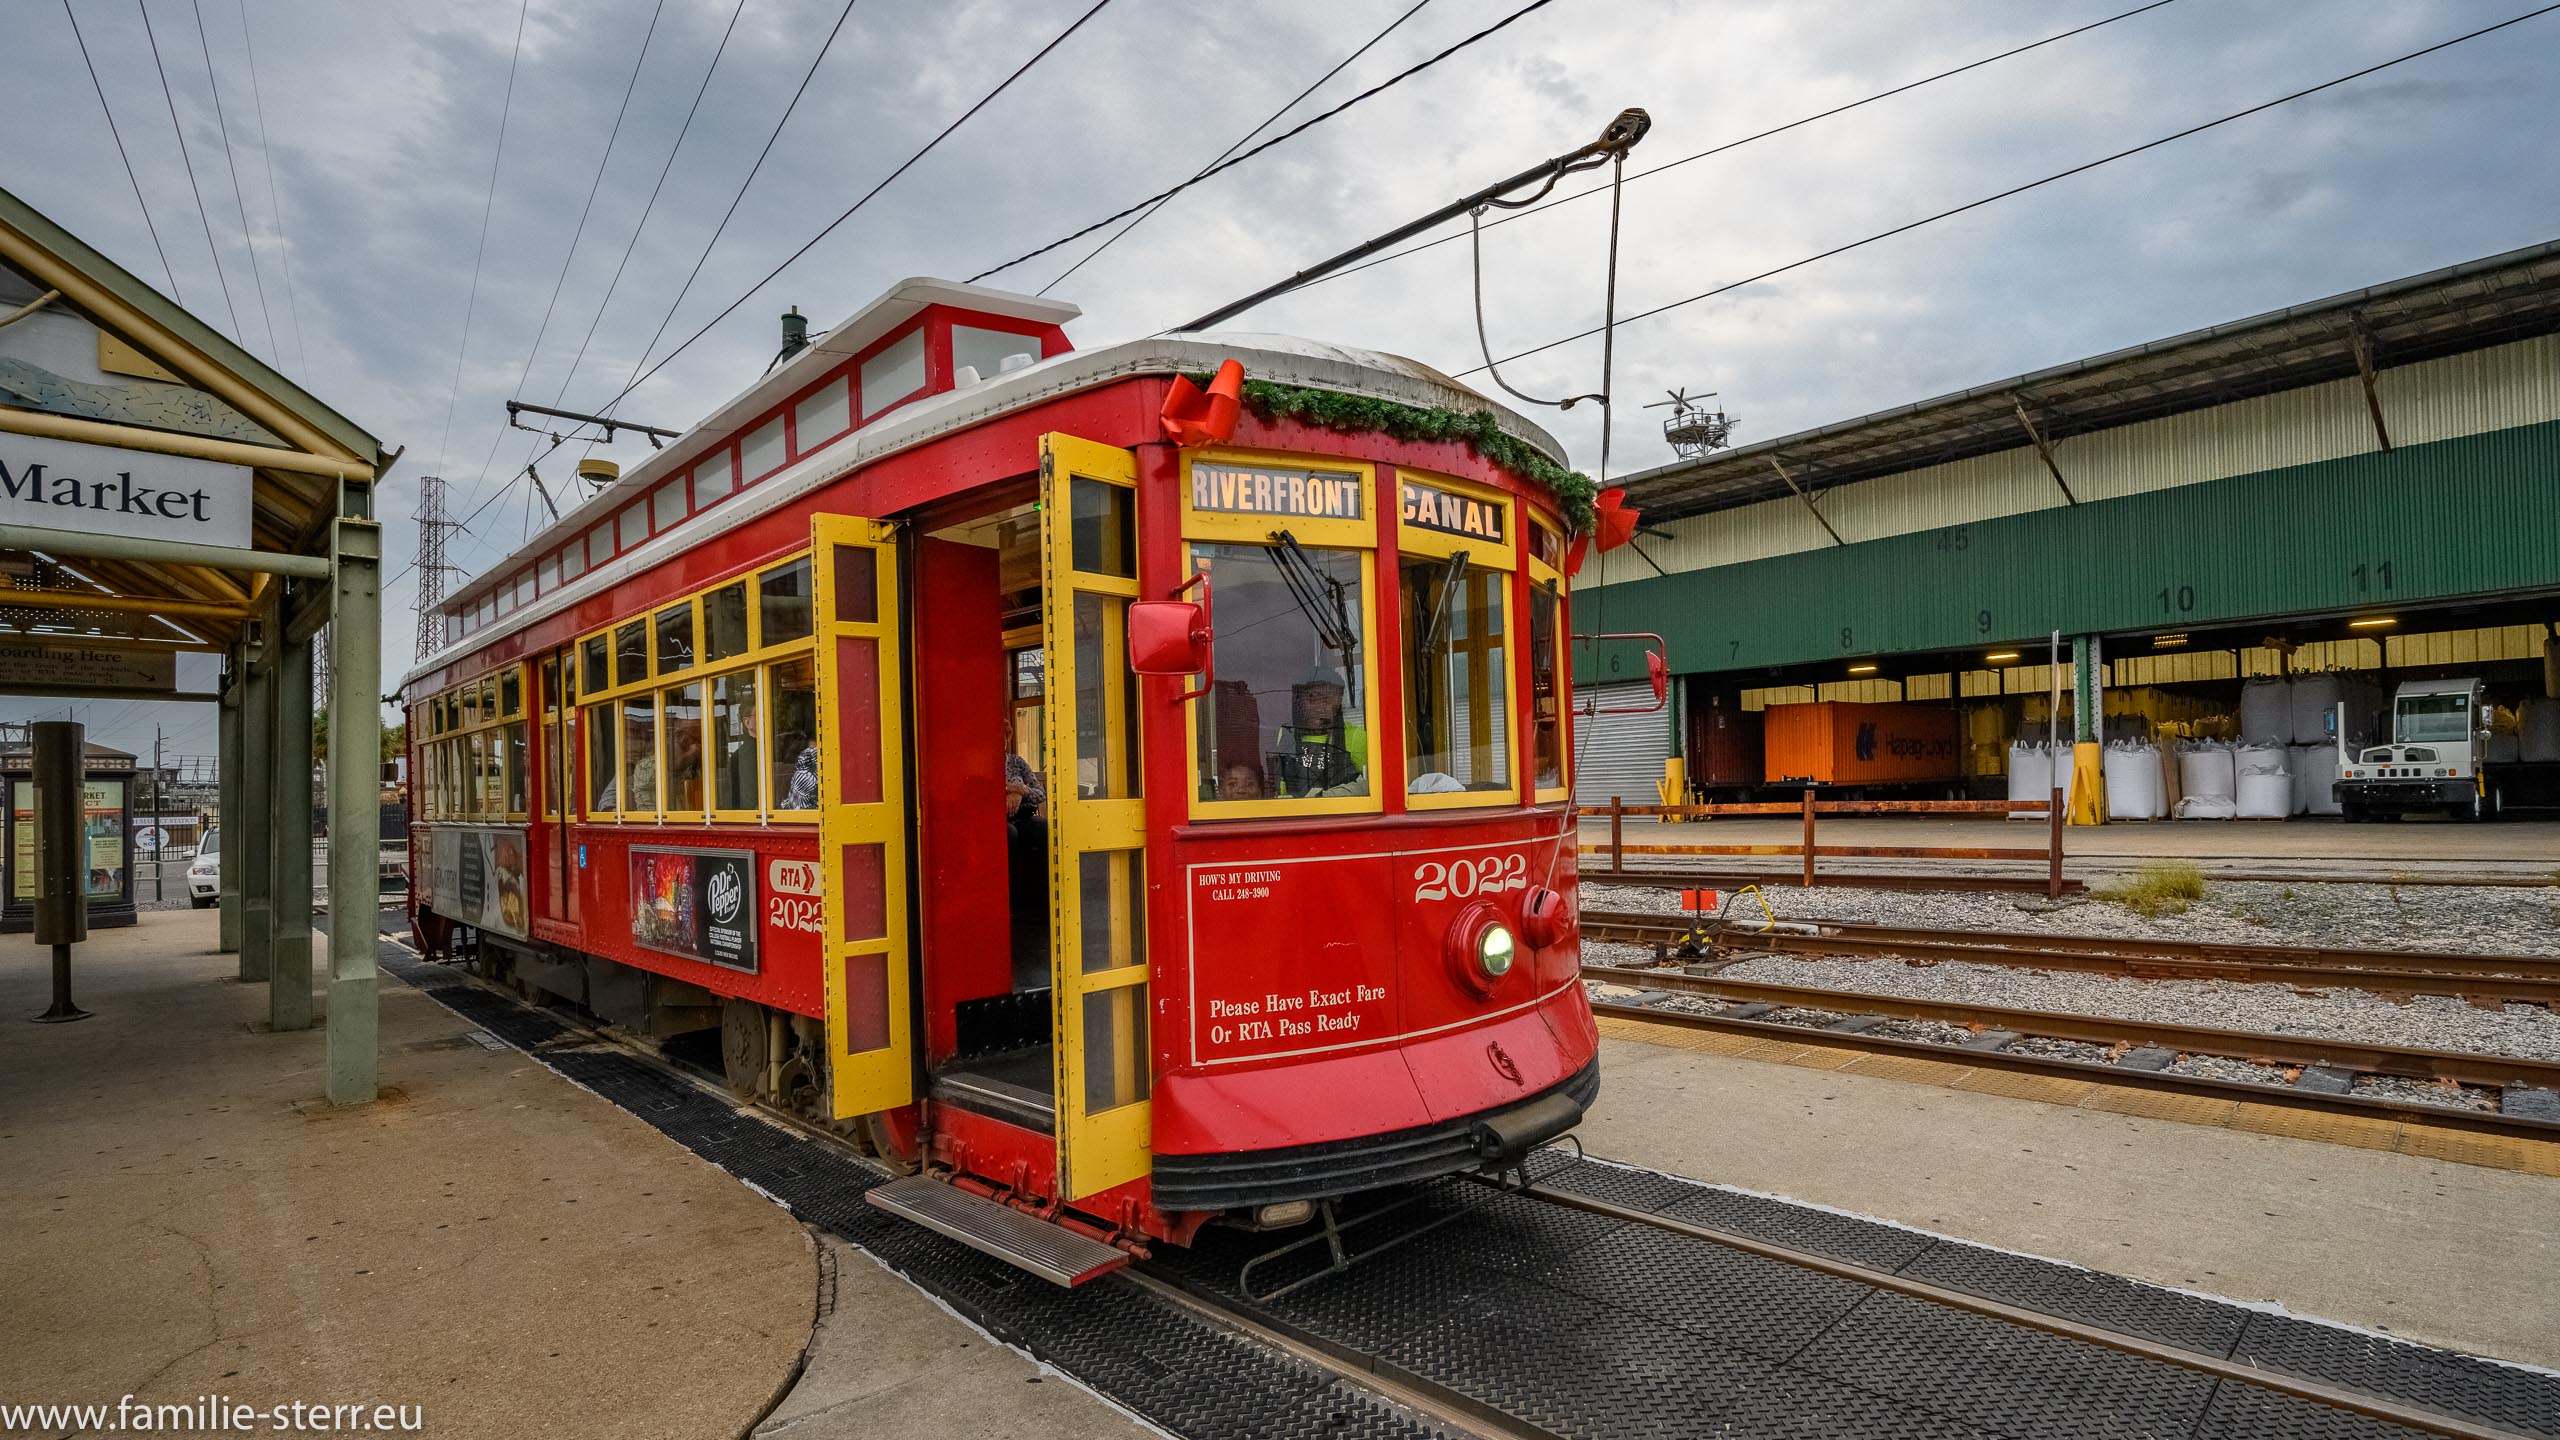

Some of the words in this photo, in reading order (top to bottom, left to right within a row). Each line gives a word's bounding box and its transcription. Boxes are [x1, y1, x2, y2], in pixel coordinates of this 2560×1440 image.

[0, 459, 211, 522] Market
[1192, 469, 1359, 517] RIVERFRONT
[1403, 487, 1500, 538] CANAL
[1937, 527, 1968, 553] 45
[2352, 561, 2393, 592] 11
[2157, 585, 2195, 614] 10
[1977, 610, 1992, 633] 9
[1729, 641, 1740, 660] 7
[1841, 627, 1853, 648] 8
[81, 650, 121, 662] Here
[1611, 654, 1620, 673] 6
[719, 871, 732, 895] Dr
[780, 867, 801, 888] RTA
[1199, 873, 1226, 886] HOW'S
[1228, 872, 1242, 885] MY
[1244, 870, 1281, 883] DRIVING
[1414, 853, 1527, 904] 2022
[708, 874, 739, 917] Pepper
[1212, 888, 1235, 901] CALL
[1236, 886, 1270, 900] 248-3900
[1210, 998, 1260, 1018] Please
[1266, 994, 1303, 1013] Have
[1309, 988, 1351, 1008] Exact
[1357, 984, 1386, 1002] Fare
[1210, 1025, 1232, 1044] Or
[1238, 1020, 1273, 1041] RTA
[1279, 1017, 1311, 1037] Pass
[1317, 1010, 1361, 1032] Ready
